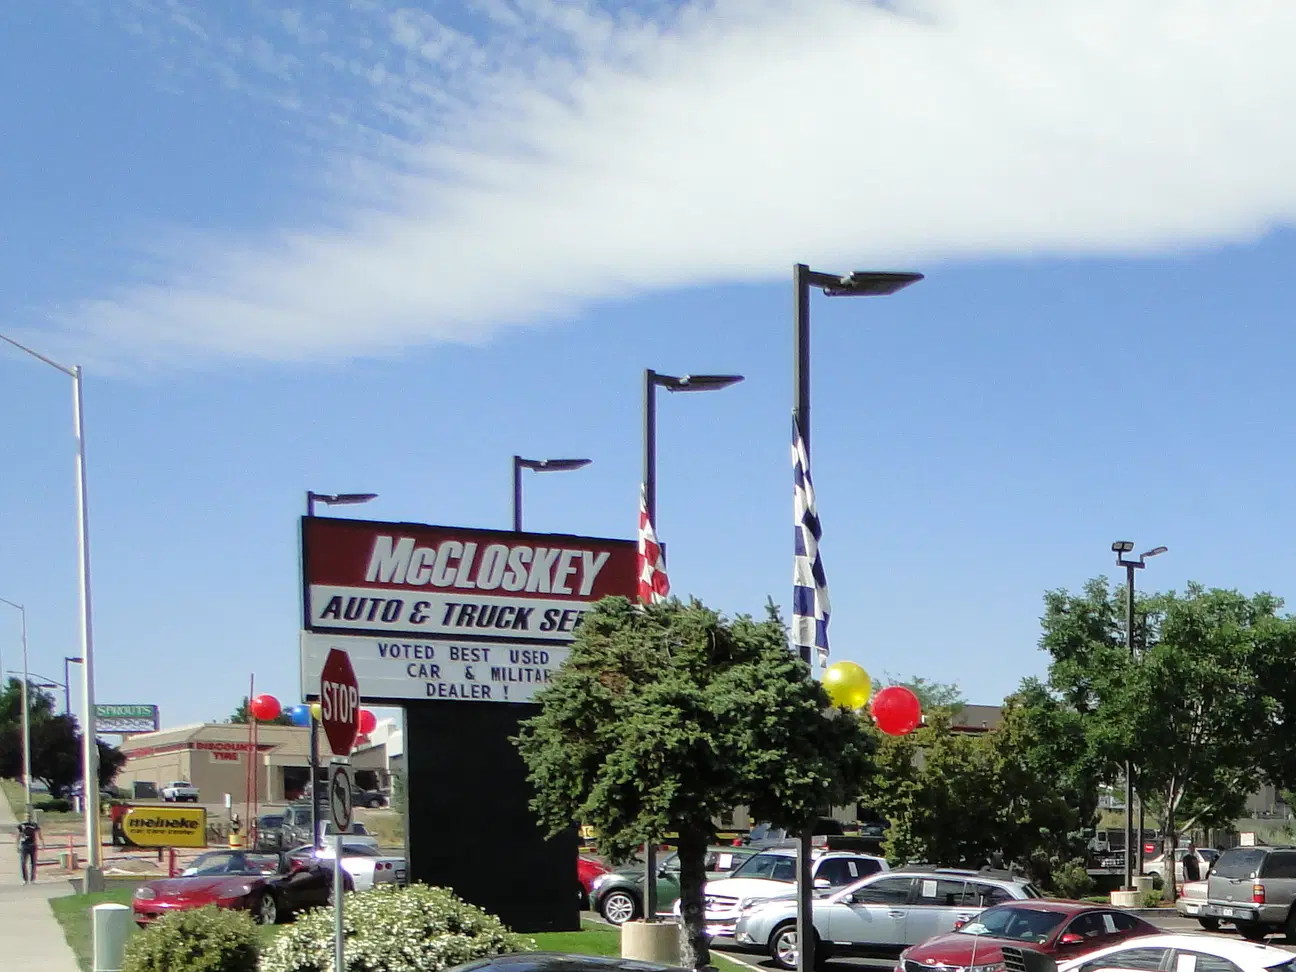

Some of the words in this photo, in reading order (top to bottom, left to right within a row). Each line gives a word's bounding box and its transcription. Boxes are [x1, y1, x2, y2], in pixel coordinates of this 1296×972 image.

[364, 535, 611, 597] McCLOSKEY
[320, 596, 405, 624] AUTO
[408, 600, 432, 625] &
[441, 602, 536, 630] TRUCK
[539, 608, 585, 632] SE
[378, 643, 434, 660] VOTED
[450, 647, 490, 663] BEST
[509, 650, 549, 665] USED
[407, 663, 441, 679] CAR
[464, 667, 476, 681] &
[491, 667, 553, 684] MILITAR
[426, 682, 491, 699] DEALER
[96, 705, 152, 717] SPROUTS
[322, 680, 357, 724] STOP
[196, 742, 255, 752] DISCOUNT
